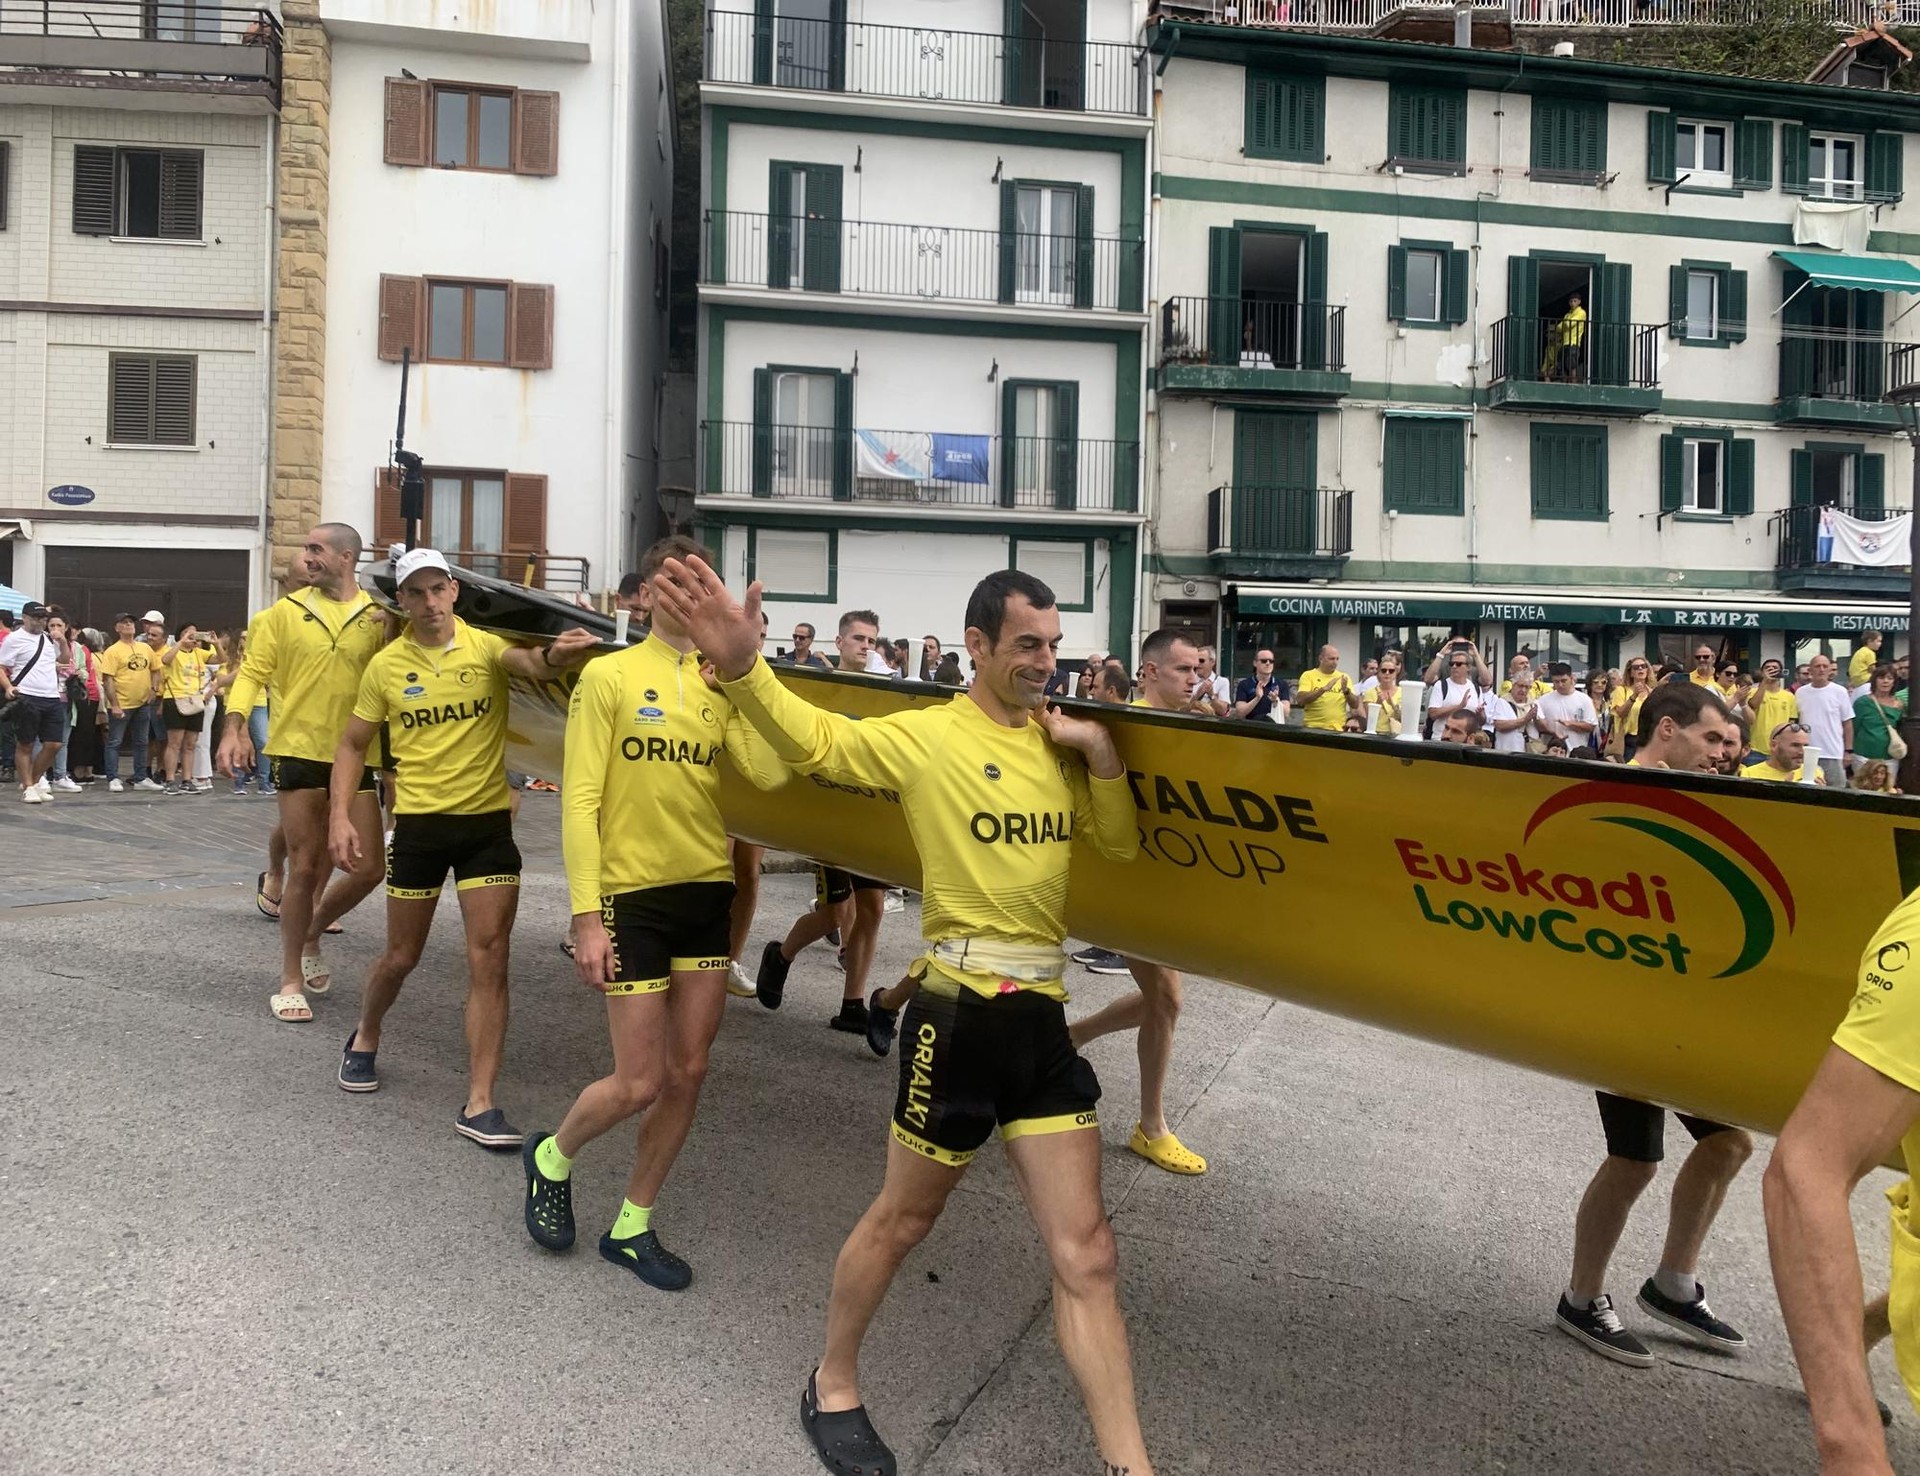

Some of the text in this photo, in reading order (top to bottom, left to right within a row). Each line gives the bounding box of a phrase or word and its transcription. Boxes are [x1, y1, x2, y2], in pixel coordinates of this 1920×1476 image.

[1269, 598, 1405, 616] COCINA MARINERA
[1479, 603, 1546, 620] JATETXEA
[1621, 609, 1760, 627] LA RAMPA
[1833, 615, 1910, 631] RESTAURAN
[1127, 769, 1330, 844] TALDE
[484, 876, 516, 884] ORIO
[1394, 838, 1676, 923] Euskadi
[1413, 884, 1691, 975] LowCost
[1865, 972, 1894, 991] ORIO
[904, 1023, 937, 1130] ORIALKI
[1075, 1112, 1099, 1126] ORI
